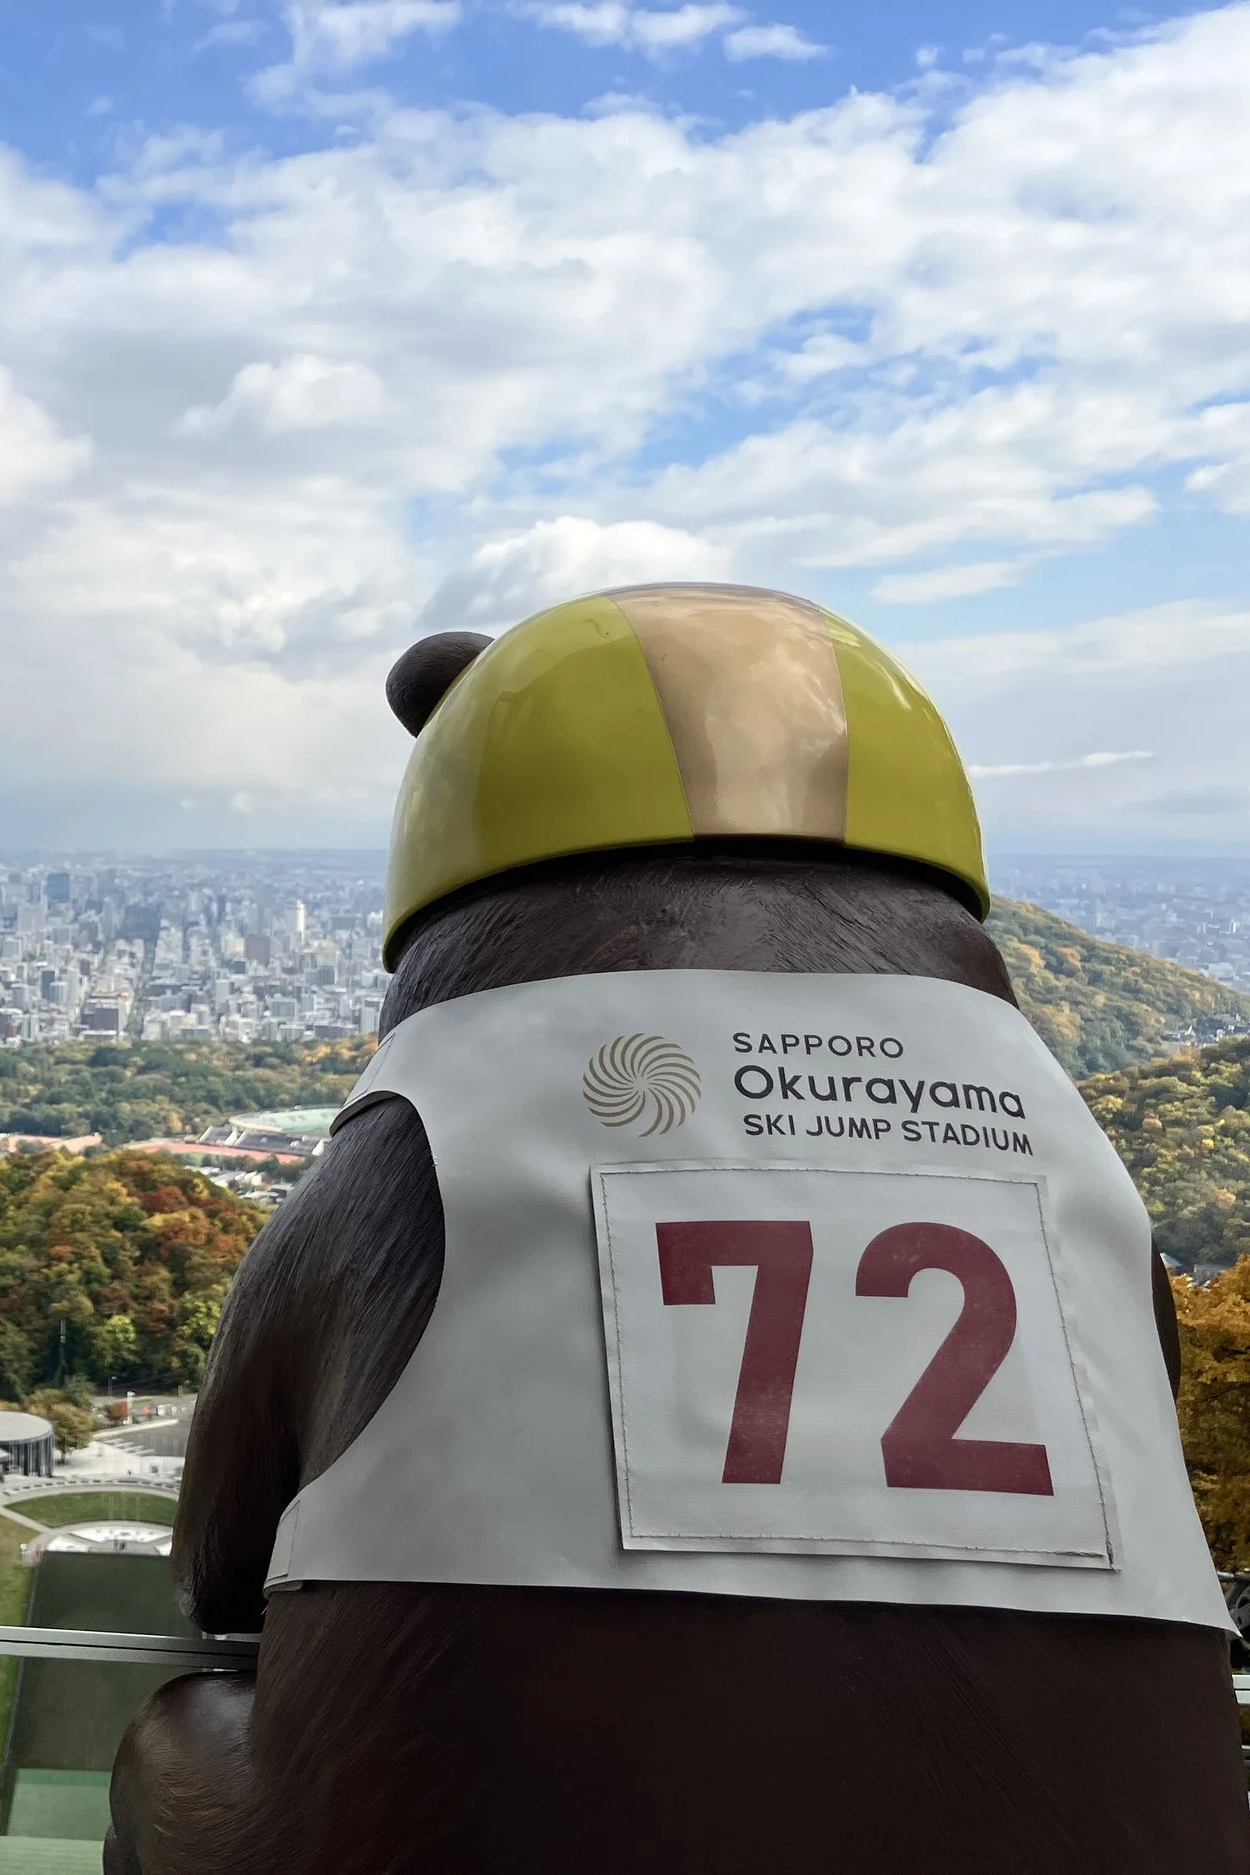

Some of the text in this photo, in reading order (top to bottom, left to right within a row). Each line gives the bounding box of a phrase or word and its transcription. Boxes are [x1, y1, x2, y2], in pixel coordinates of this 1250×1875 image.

[732, 1032, 904, 1059] SAPPORO
[734, 1065, 1026, 1120] Okurayama
[743, 1113, 1034, 1157] SKI JUMP STADIUM
[655, 1220, 1054, 1496] 72
